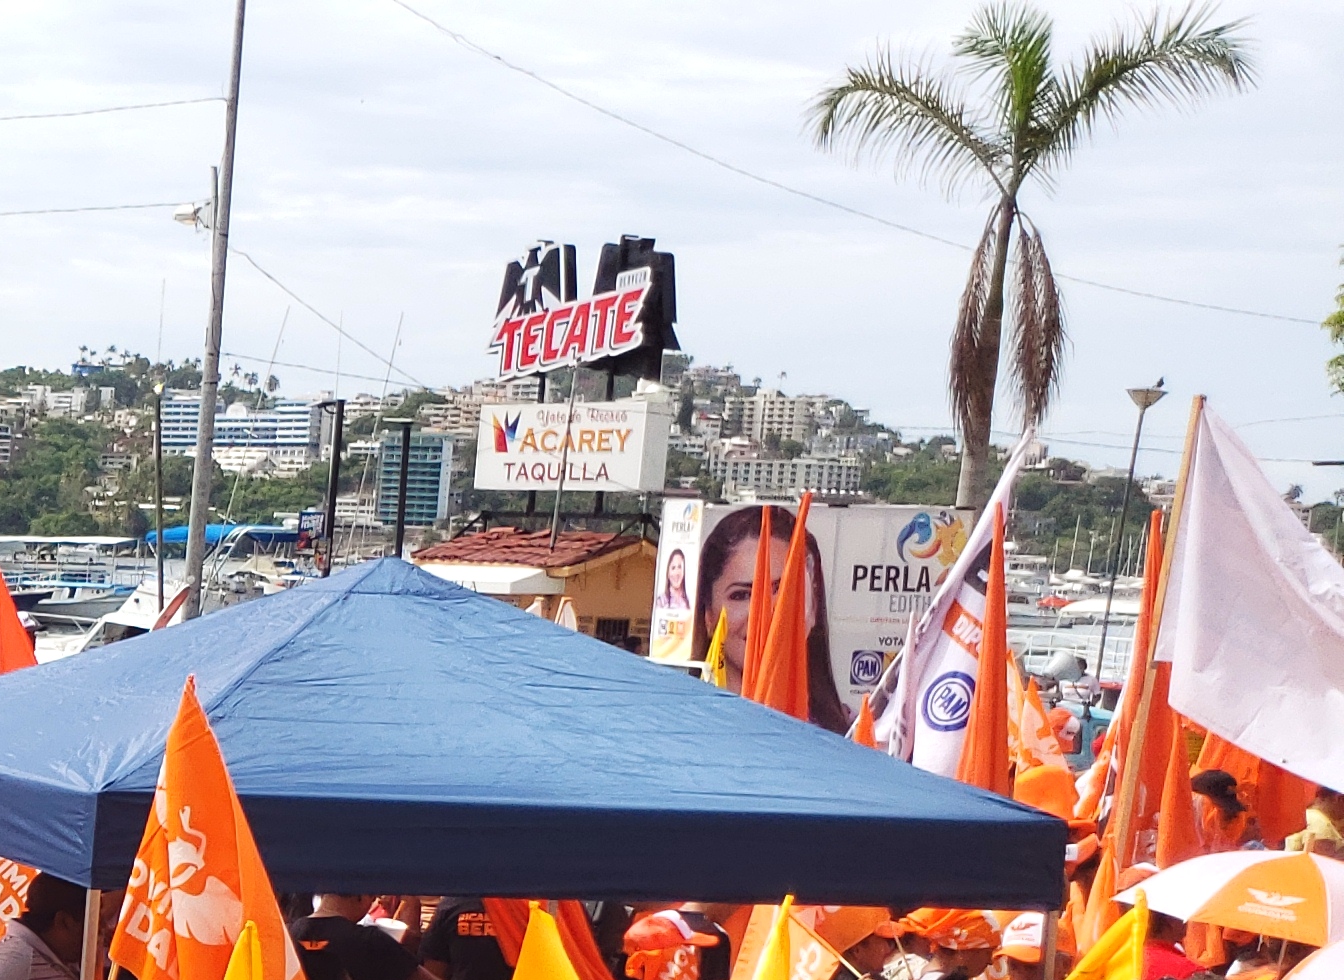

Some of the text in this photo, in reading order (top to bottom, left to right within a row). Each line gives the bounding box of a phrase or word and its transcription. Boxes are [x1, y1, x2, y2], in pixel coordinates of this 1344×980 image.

[496, 288, 644, 371] TECATE
[519, 428, 633, 452] ACAREY
[503, 462, 610, 483] TAQULLA
[851, 564, 931, 592] PERLA
[889, 594, 932, 613] EDITH
[878, 637, 904, 647] VOTA
[856, 660, 878, 677] PAN
[934, 687, 969, 718] PAN
